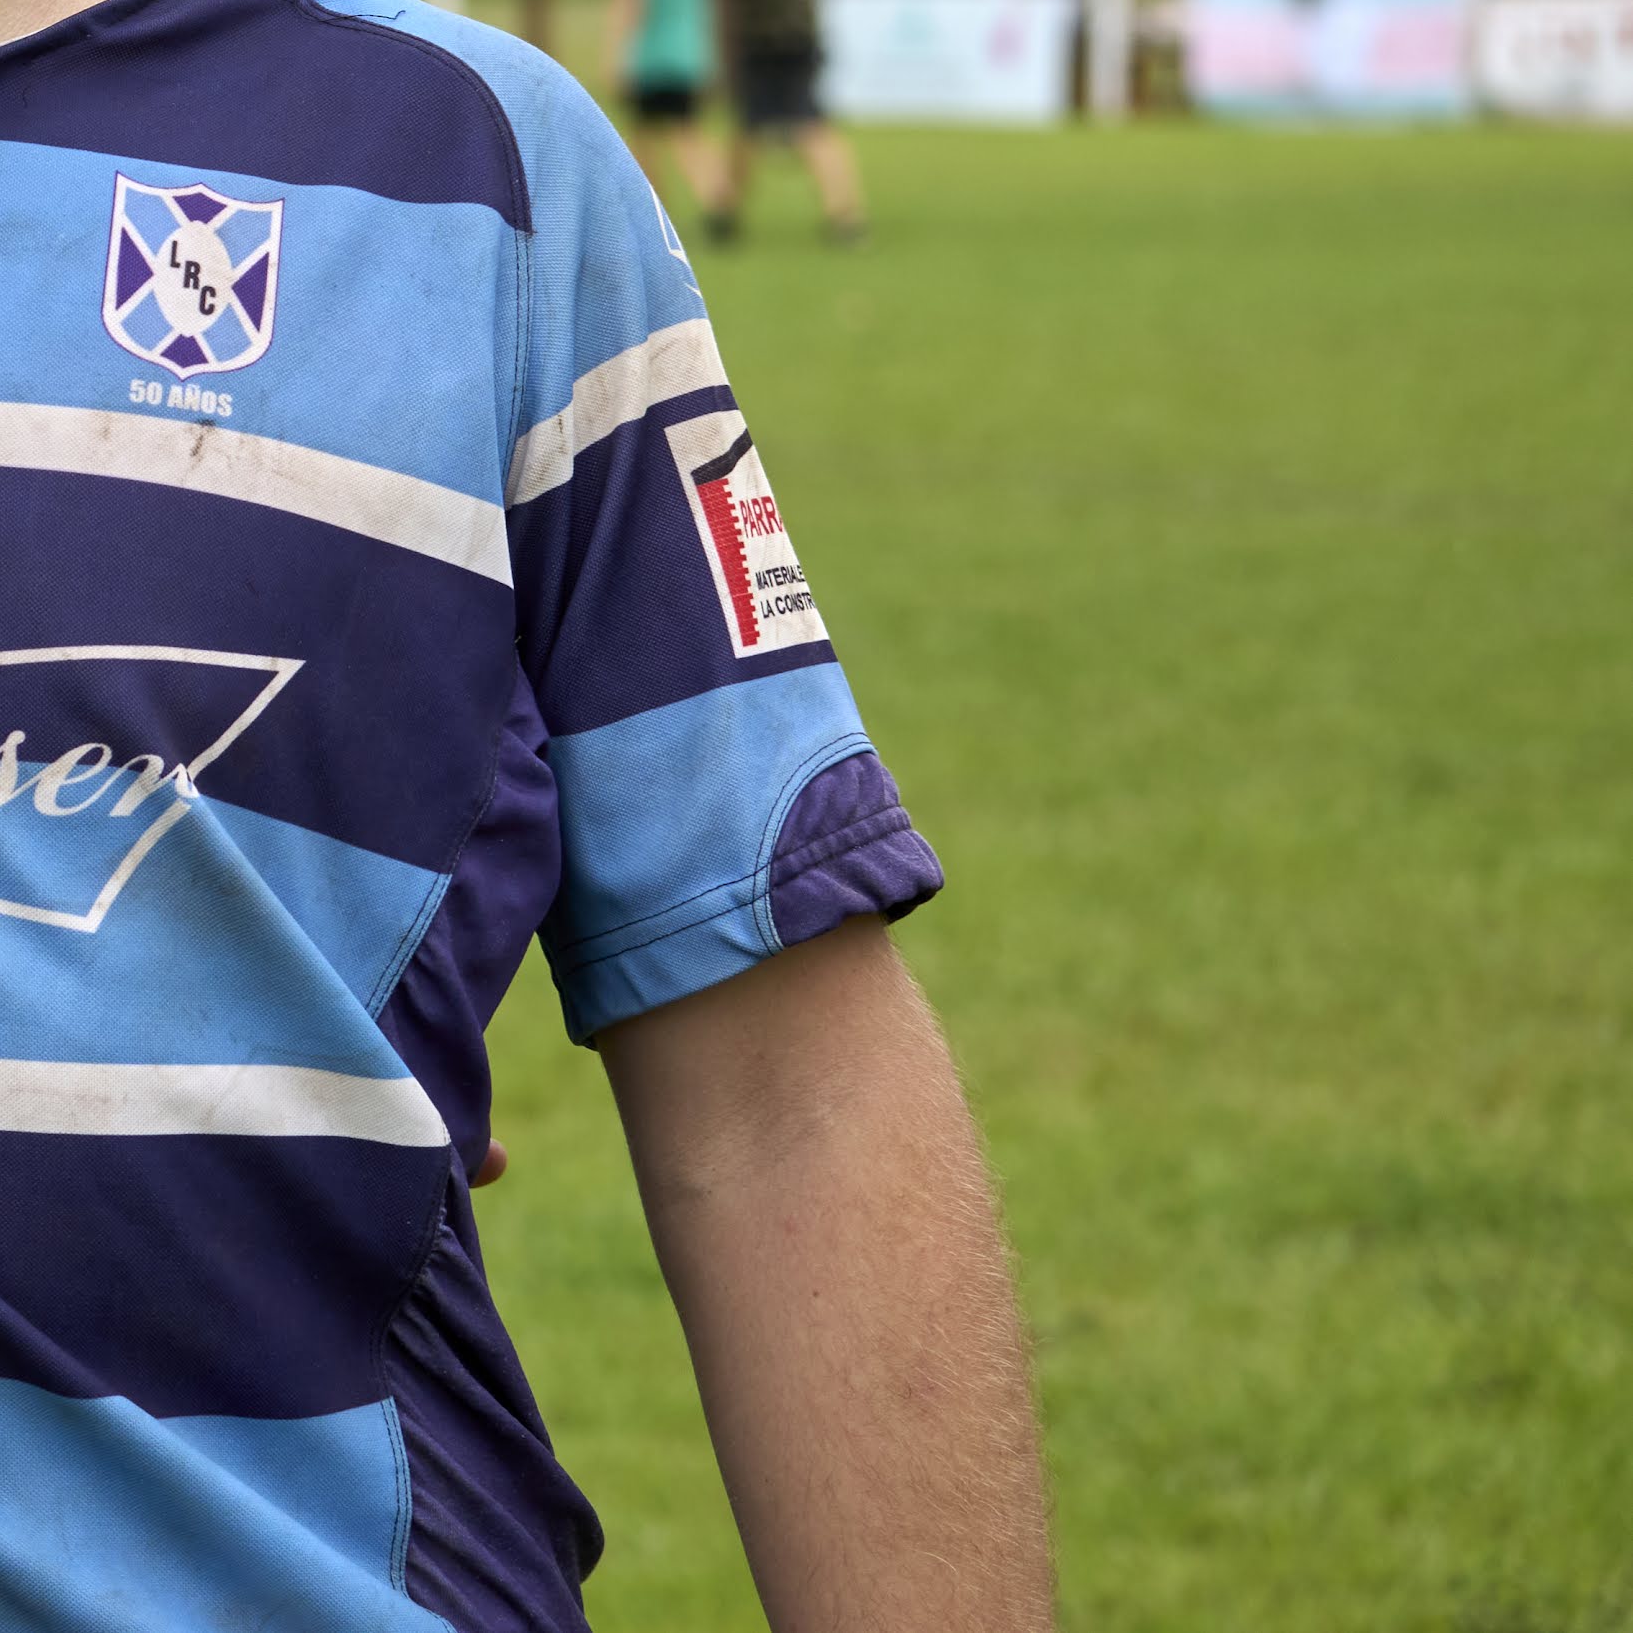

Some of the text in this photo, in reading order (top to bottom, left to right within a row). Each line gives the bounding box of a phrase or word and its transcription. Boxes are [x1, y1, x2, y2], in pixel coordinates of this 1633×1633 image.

[129, 379, 233, 417] 50 AÑOS
[739, 495, 783, 539] PARR
[760, 599, 776, 619] LA
